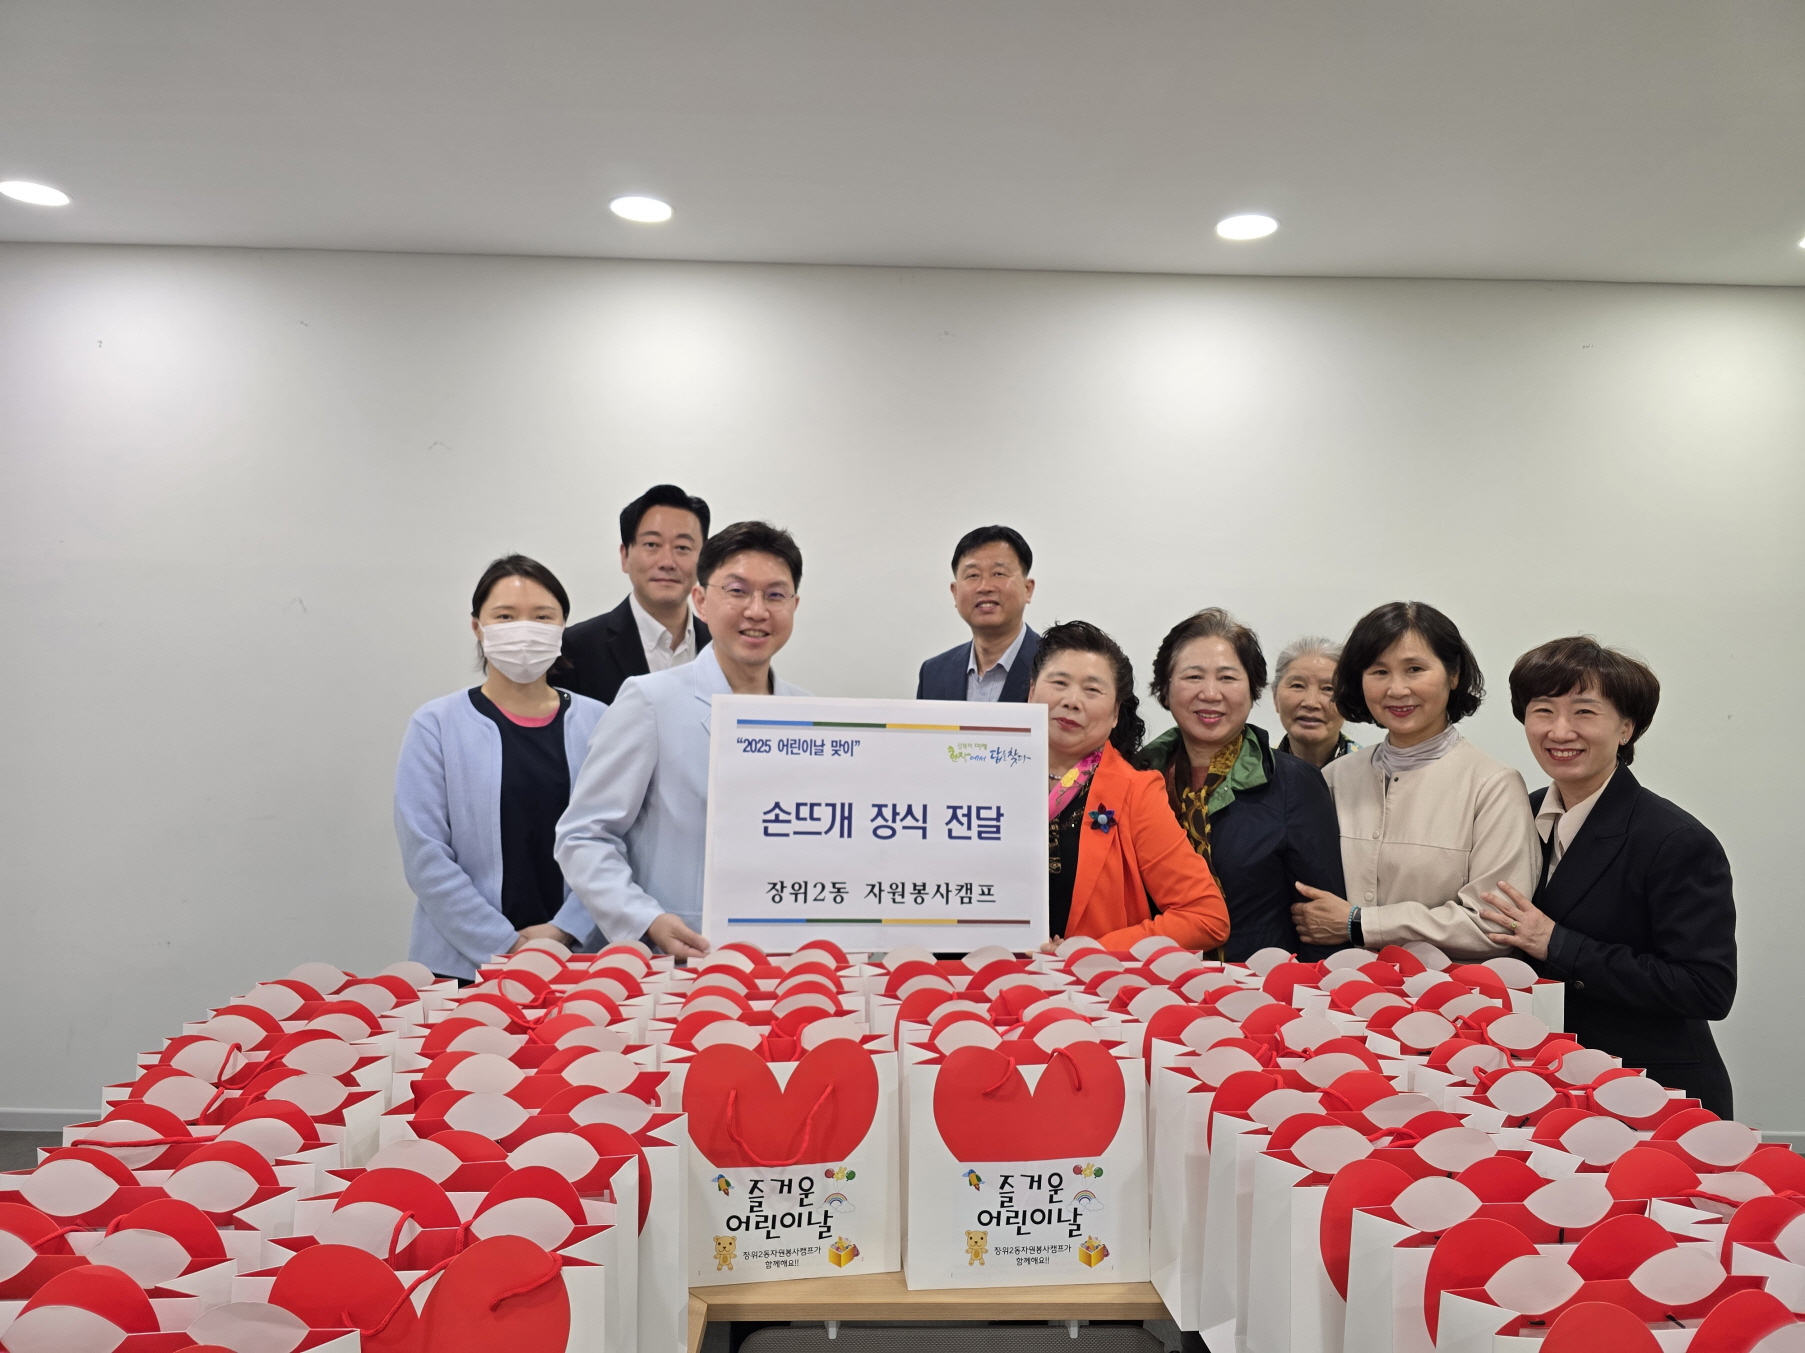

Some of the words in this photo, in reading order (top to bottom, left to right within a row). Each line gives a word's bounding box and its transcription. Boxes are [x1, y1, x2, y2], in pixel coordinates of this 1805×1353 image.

[737, 737, 771, 753] “2025
[777, 738, 826, 756] 어린이날
[830, 739, 861, 757] 맞이”
[762, 802, 853, 839] 손뜨개
[871, 804, 928, 841] 장식
[944, 804, 1005, 841] 전달
[766, 880, 849, 906] 장위2동
[864, 881, 996, 907] 자원봉사캠프
[748, 1176, 815, 1214] 즐거운
[998, 1172, 1064, 1209] 즐거운
[725, 1209, 834, 1240] 어린이날
[977, 1207, 1083, 1238] 어린이날
[742, 1246, 821, 1261] 장위2동자원봉사캠프가
[994, 1244, 1072, 1256] 장위2동자원봉사캠프가
